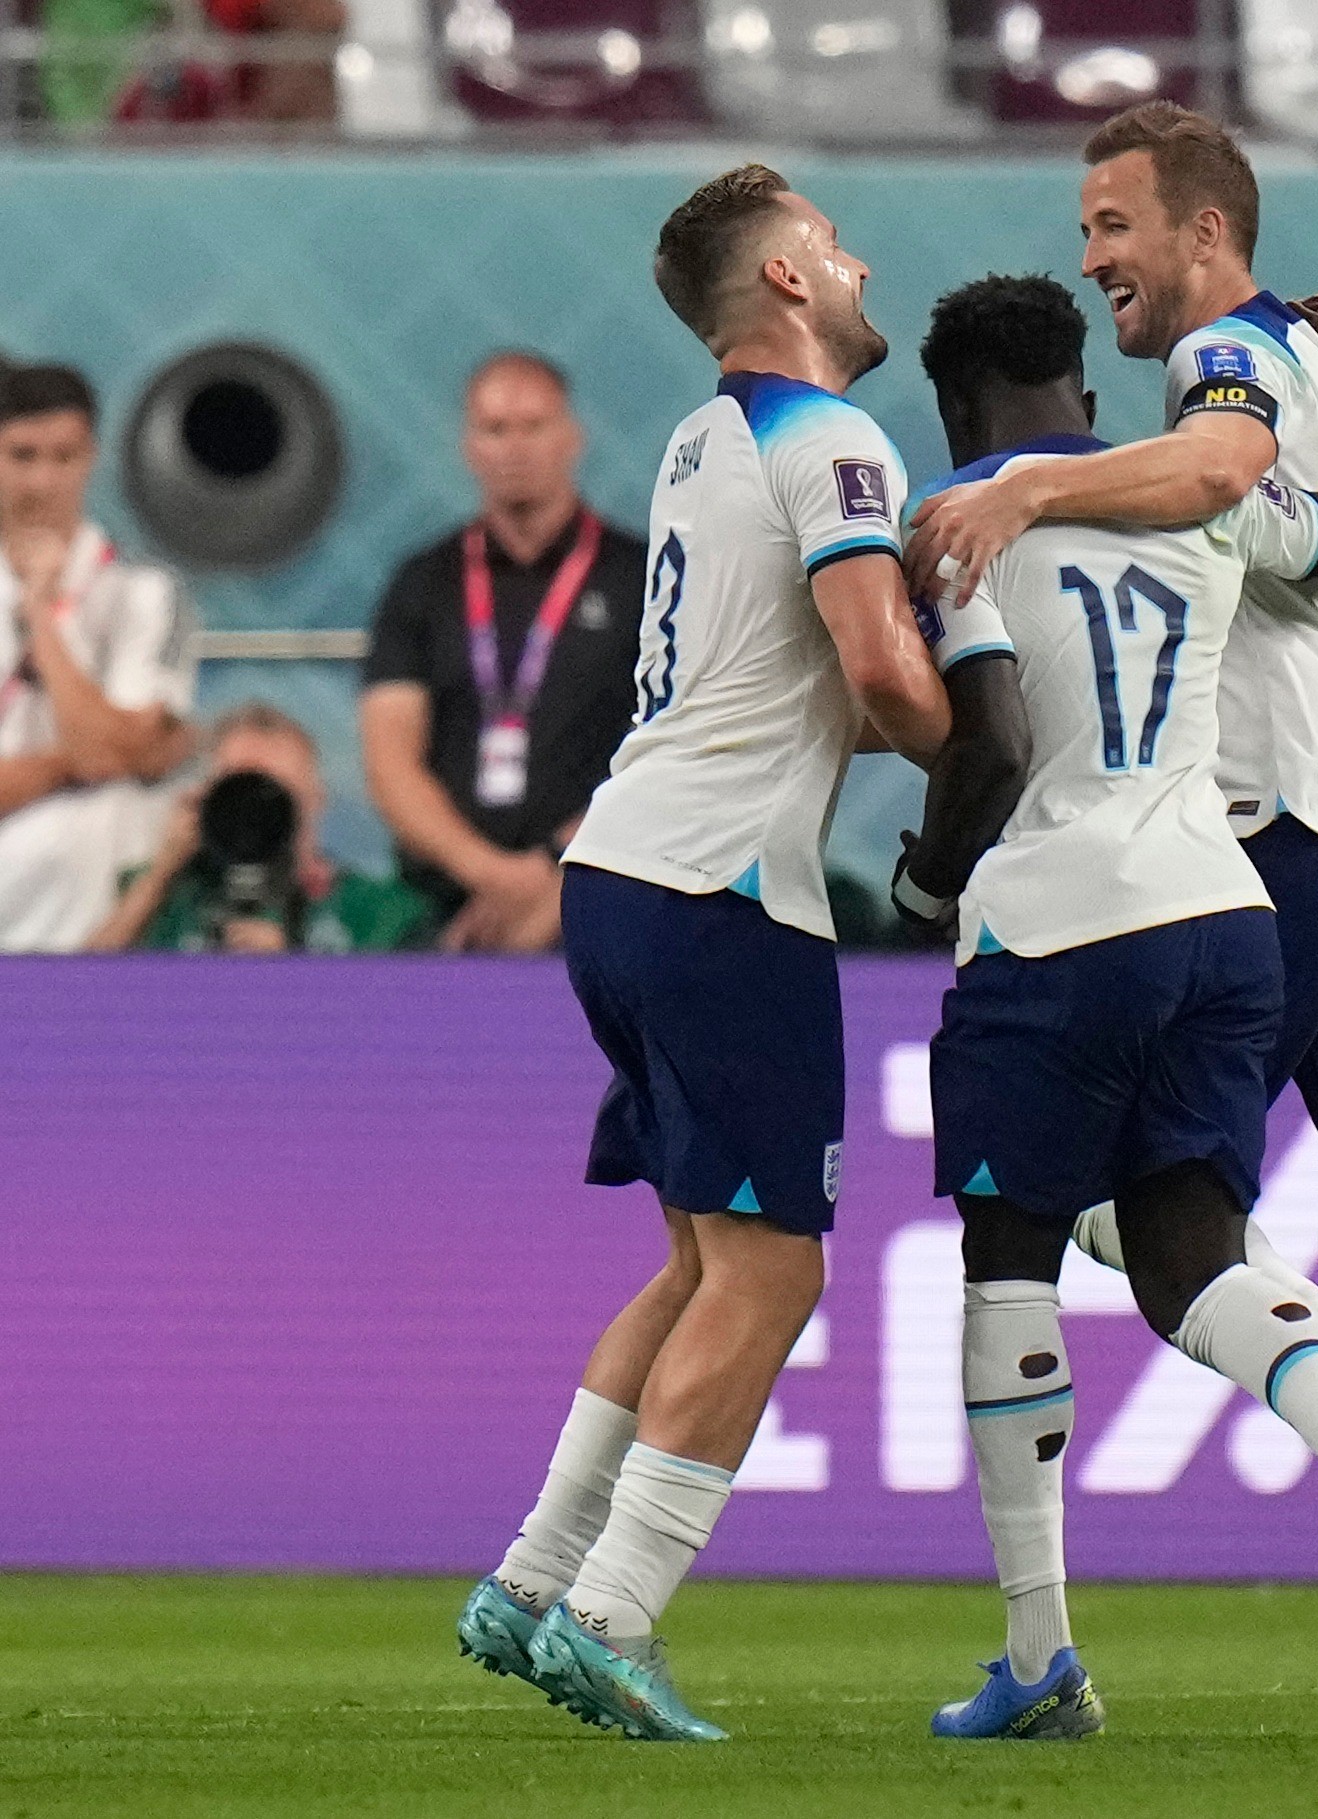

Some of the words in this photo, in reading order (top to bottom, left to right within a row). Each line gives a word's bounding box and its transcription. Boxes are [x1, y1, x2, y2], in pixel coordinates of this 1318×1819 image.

[1205, 387, 1248, 404] NO
[641, 526, 686, 725] 3
[1058, 562, 1191, 771] 17
[1009, 1695, 1061, 1733] balance
